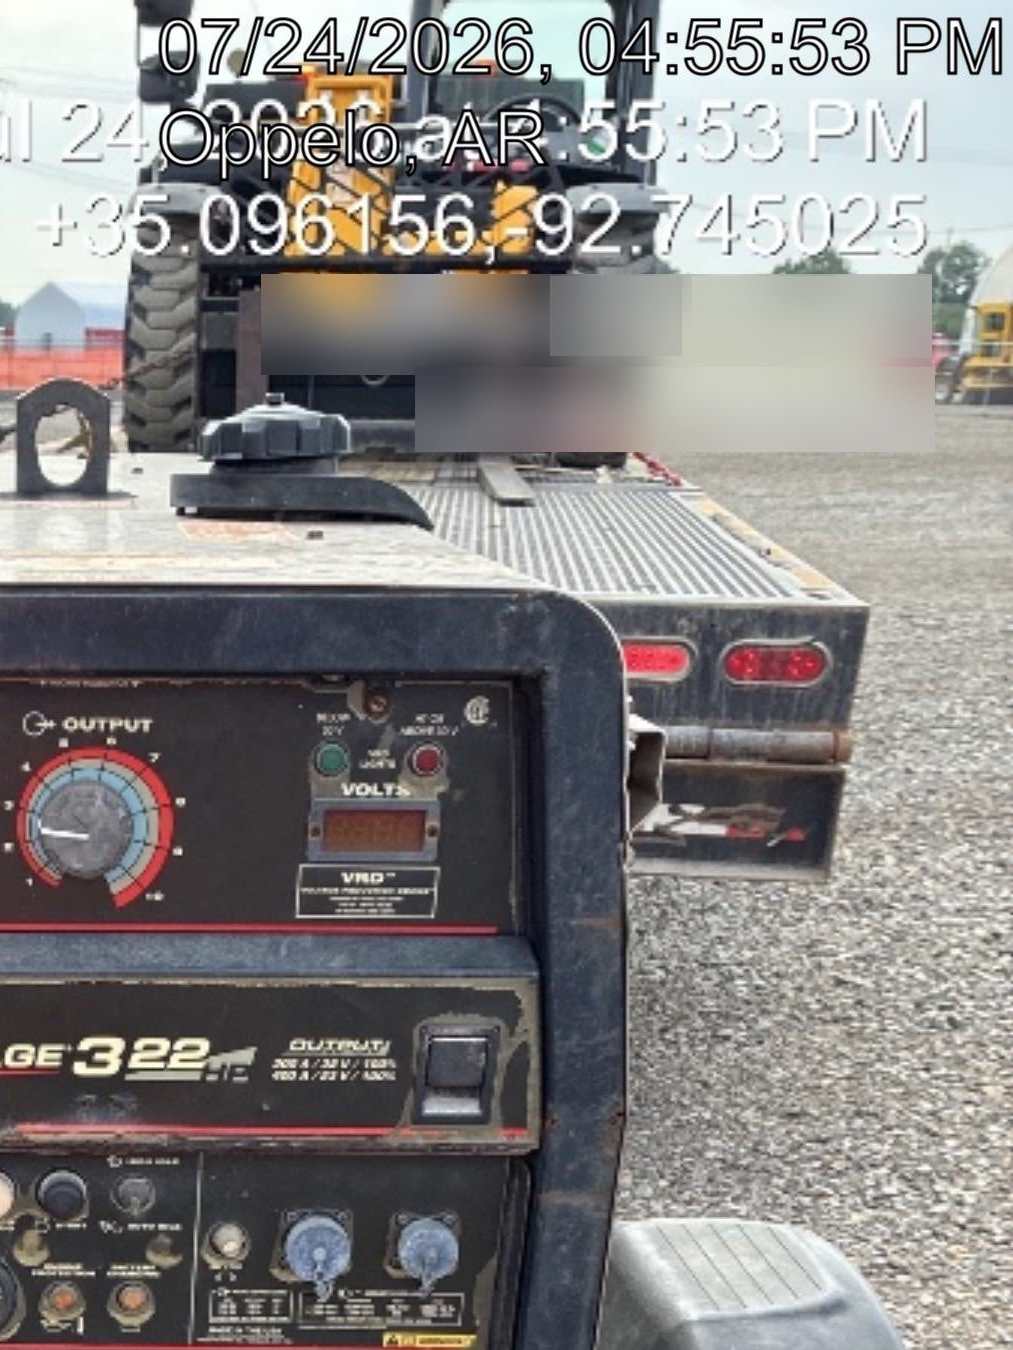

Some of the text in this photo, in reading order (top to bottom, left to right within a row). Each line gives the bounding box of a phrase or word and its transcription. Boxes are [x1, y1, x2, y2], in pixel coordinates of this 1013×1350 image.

[62, 716, 154, 733] OUTPUT
[149, 752, 161, 763] 7
[21, 761, 31, 772] 4
[340, 782, 411, 798] VOLTS
[72, 1036, 212, 1077] 322
